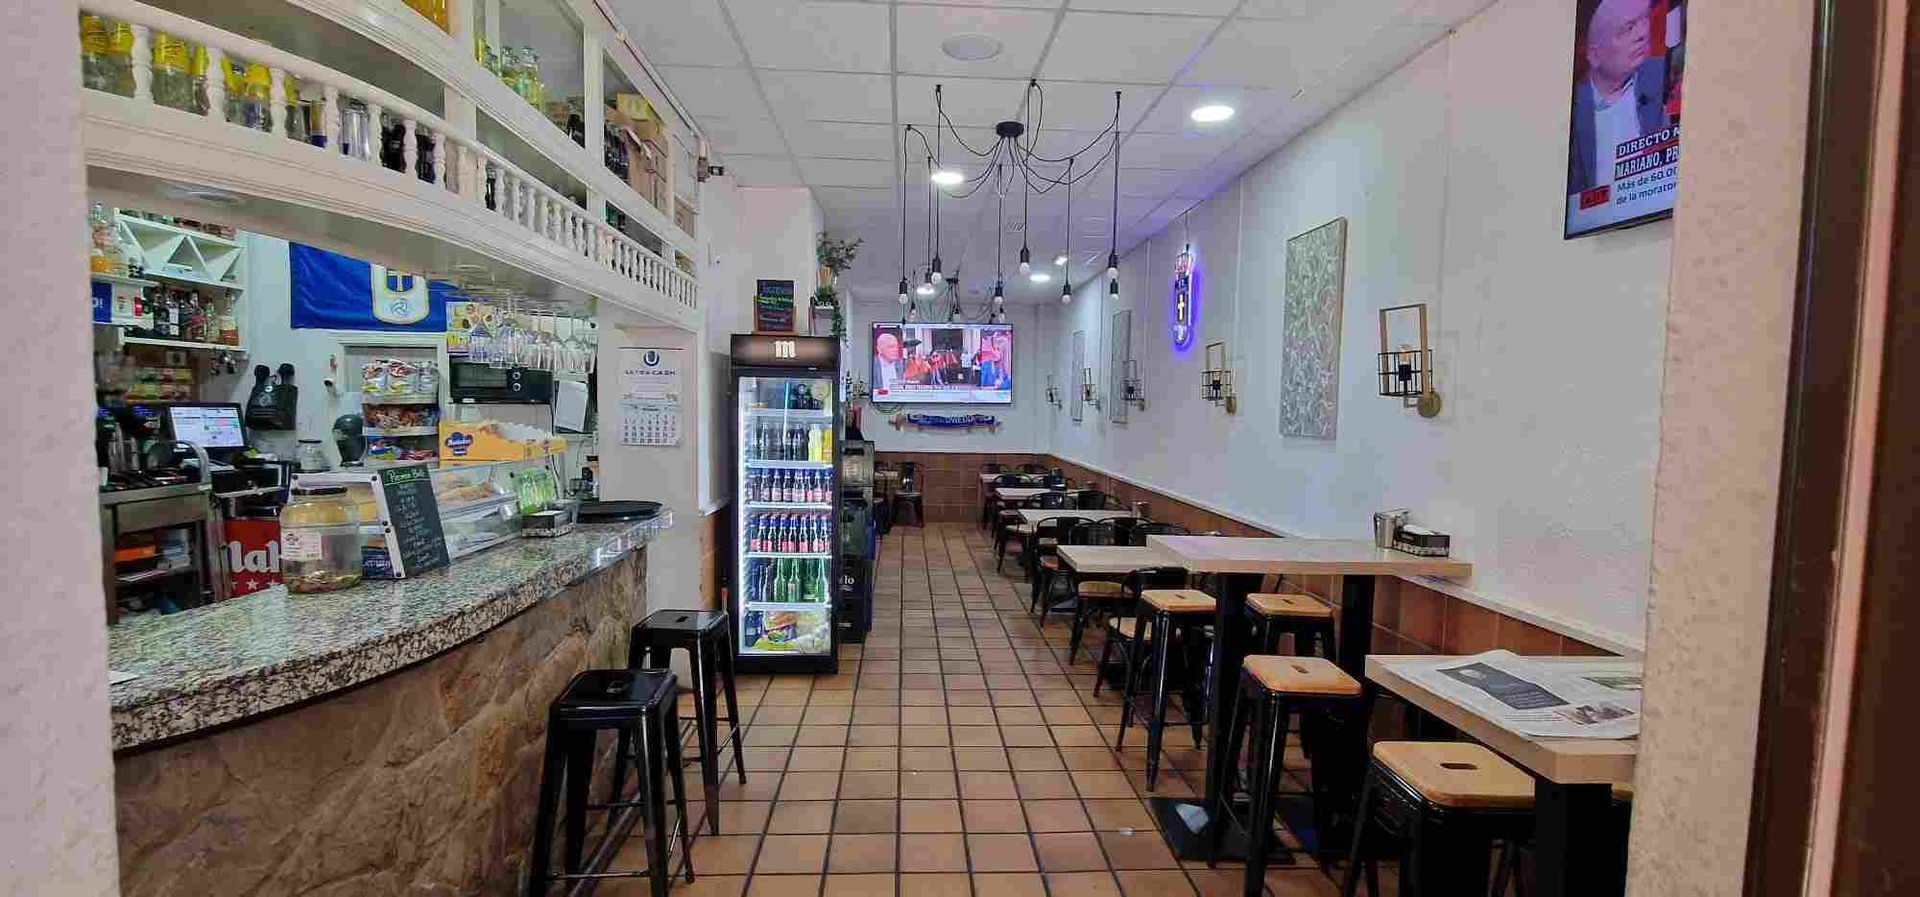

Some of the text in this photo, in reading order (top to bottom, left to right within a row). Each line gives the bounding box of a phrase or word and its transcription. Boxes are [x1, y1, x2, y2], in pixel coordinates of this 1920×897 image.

[1619, 129, 1670, 156] DIRECTO
[1615, 152, 1663, 177] MARIANO,
[1637, 176, 1650, 186] de
[1616, 195, 1628, 205] de
[1629, 191, 1637, 201] la
